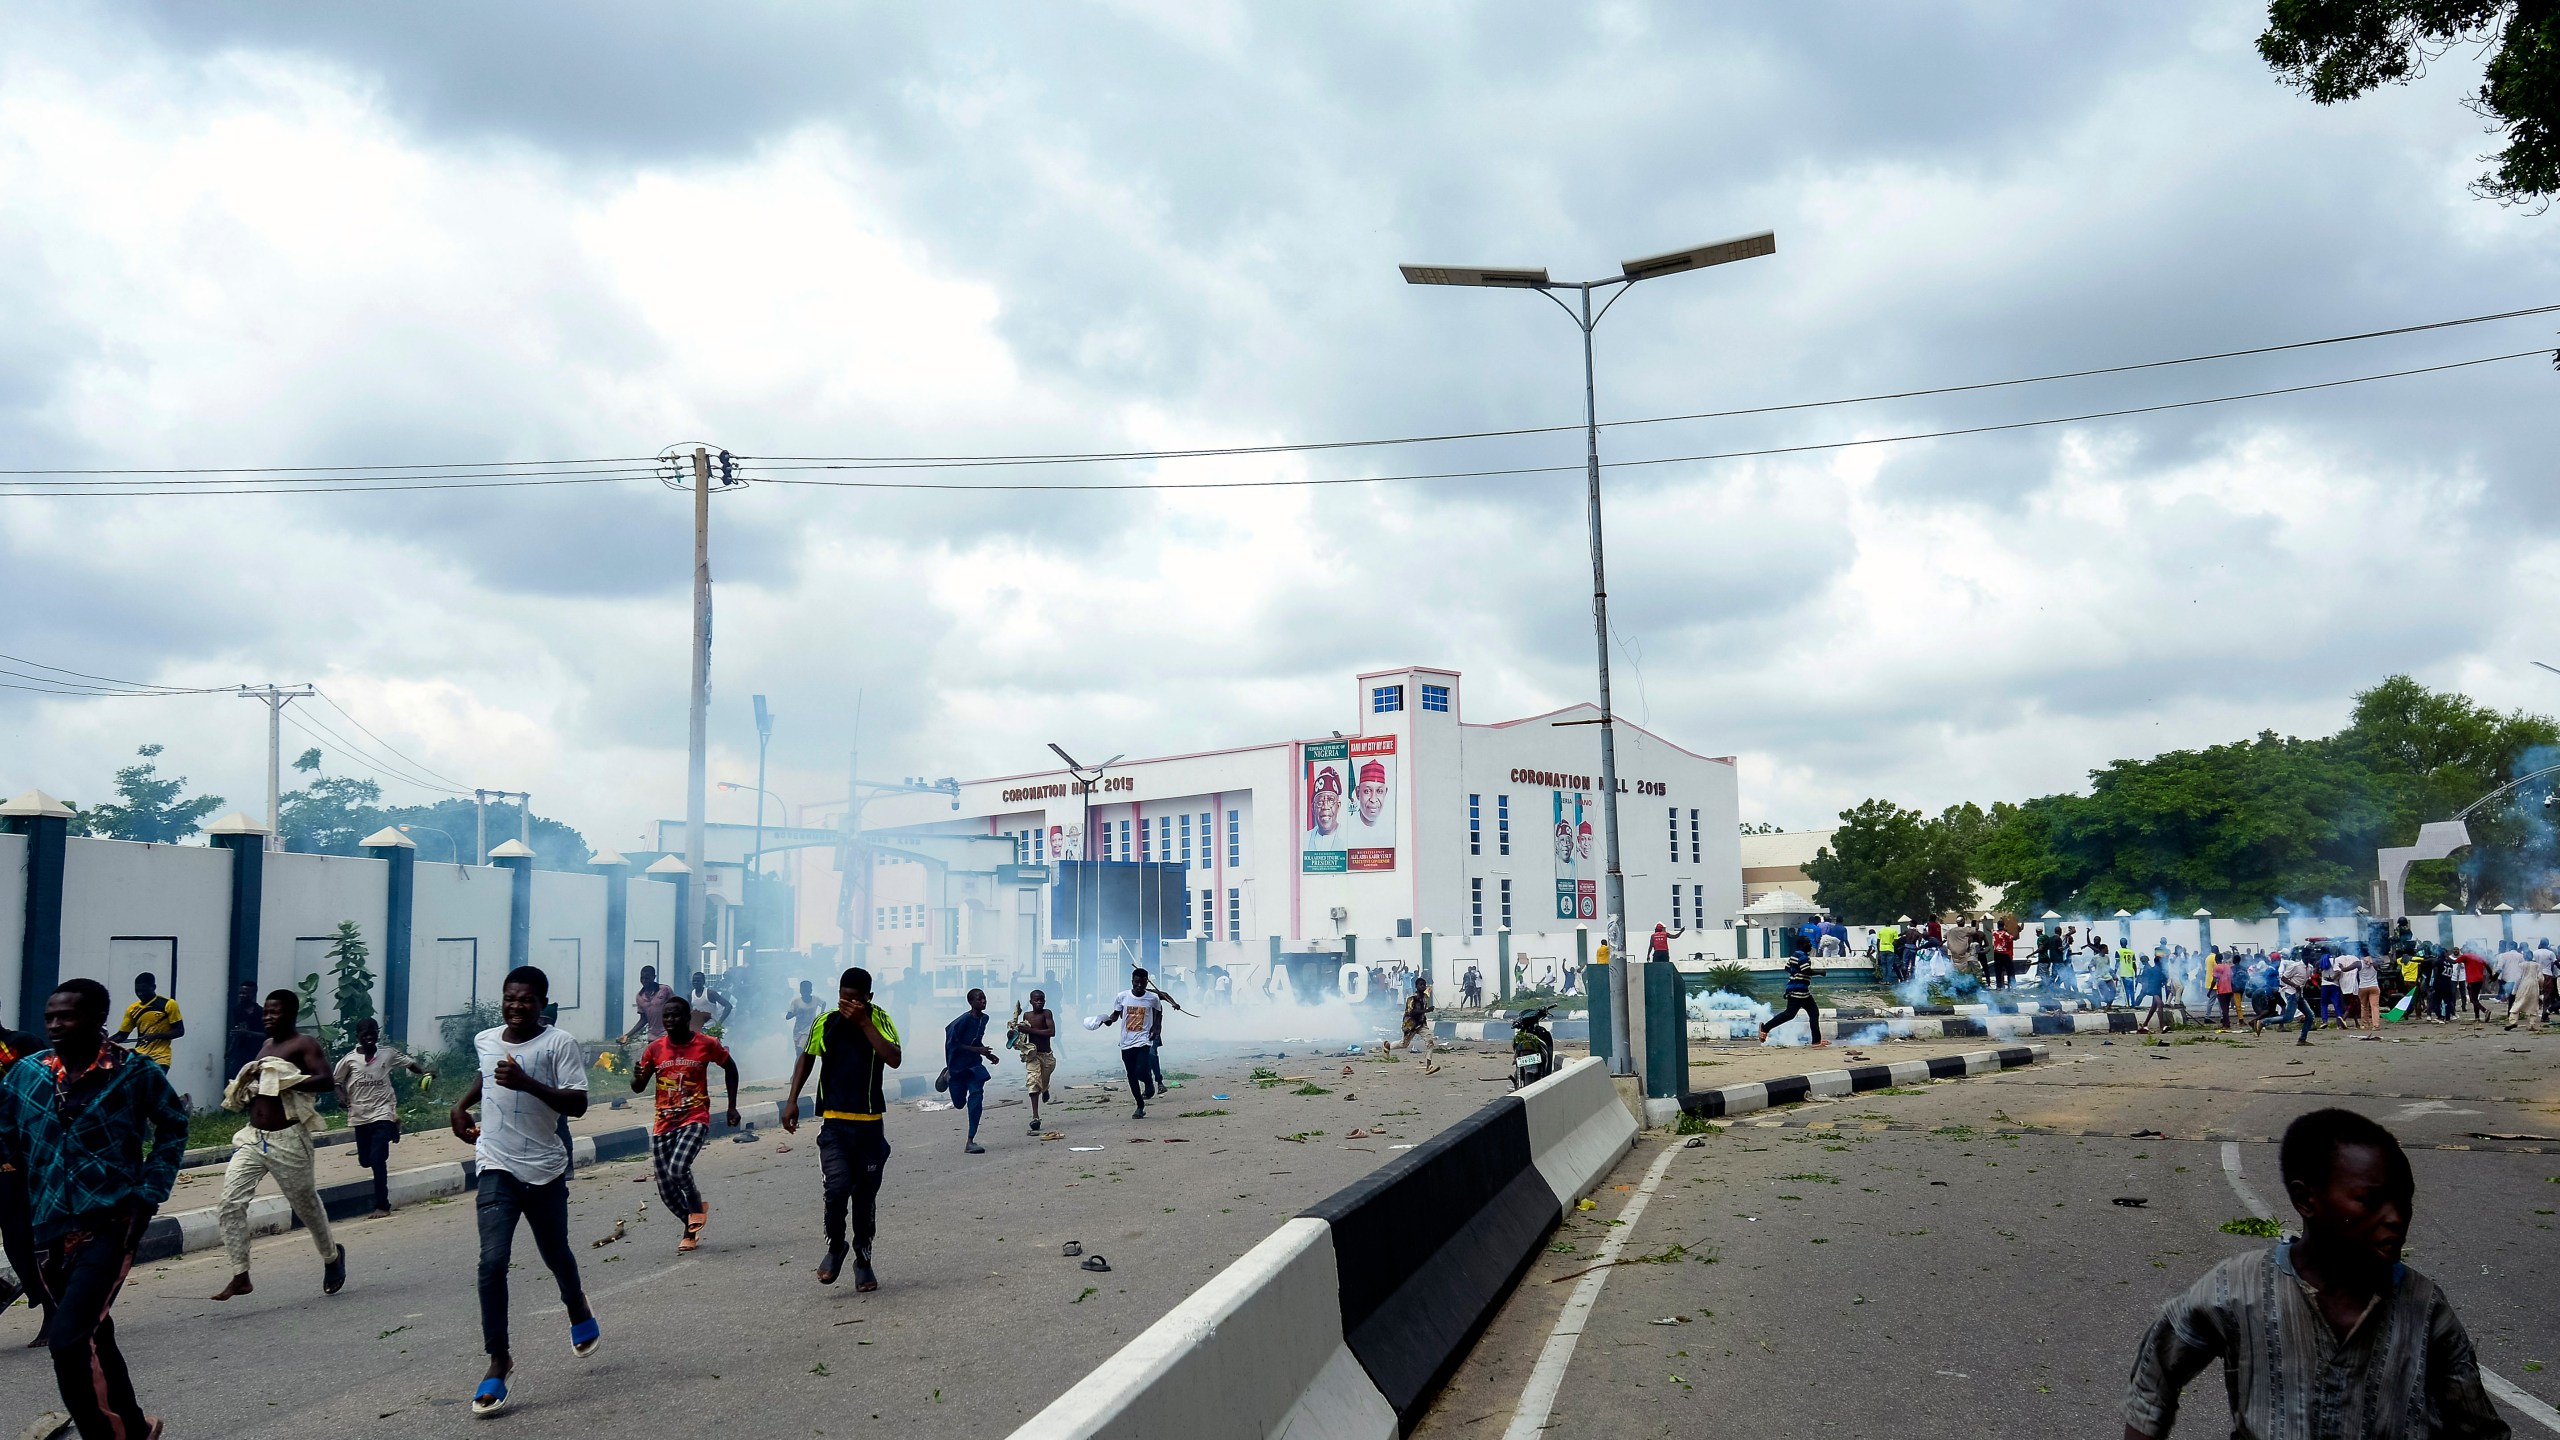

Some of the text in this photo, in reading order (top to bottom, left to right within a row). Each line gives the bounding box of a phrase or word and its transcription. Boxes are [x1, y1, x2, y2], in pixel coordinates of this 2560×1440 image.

[1368, 742, 1376, 751] CITY
[1313, 750, 1339, 758] NIGERIA
[1511, 768, 1667, 796] CORONATION HLL 2015
[1002, 783, 1067, 802] CORONATION
[1104, 777, 1134, 792] 2015
[355, 1079, 384, 1088] Emirates
